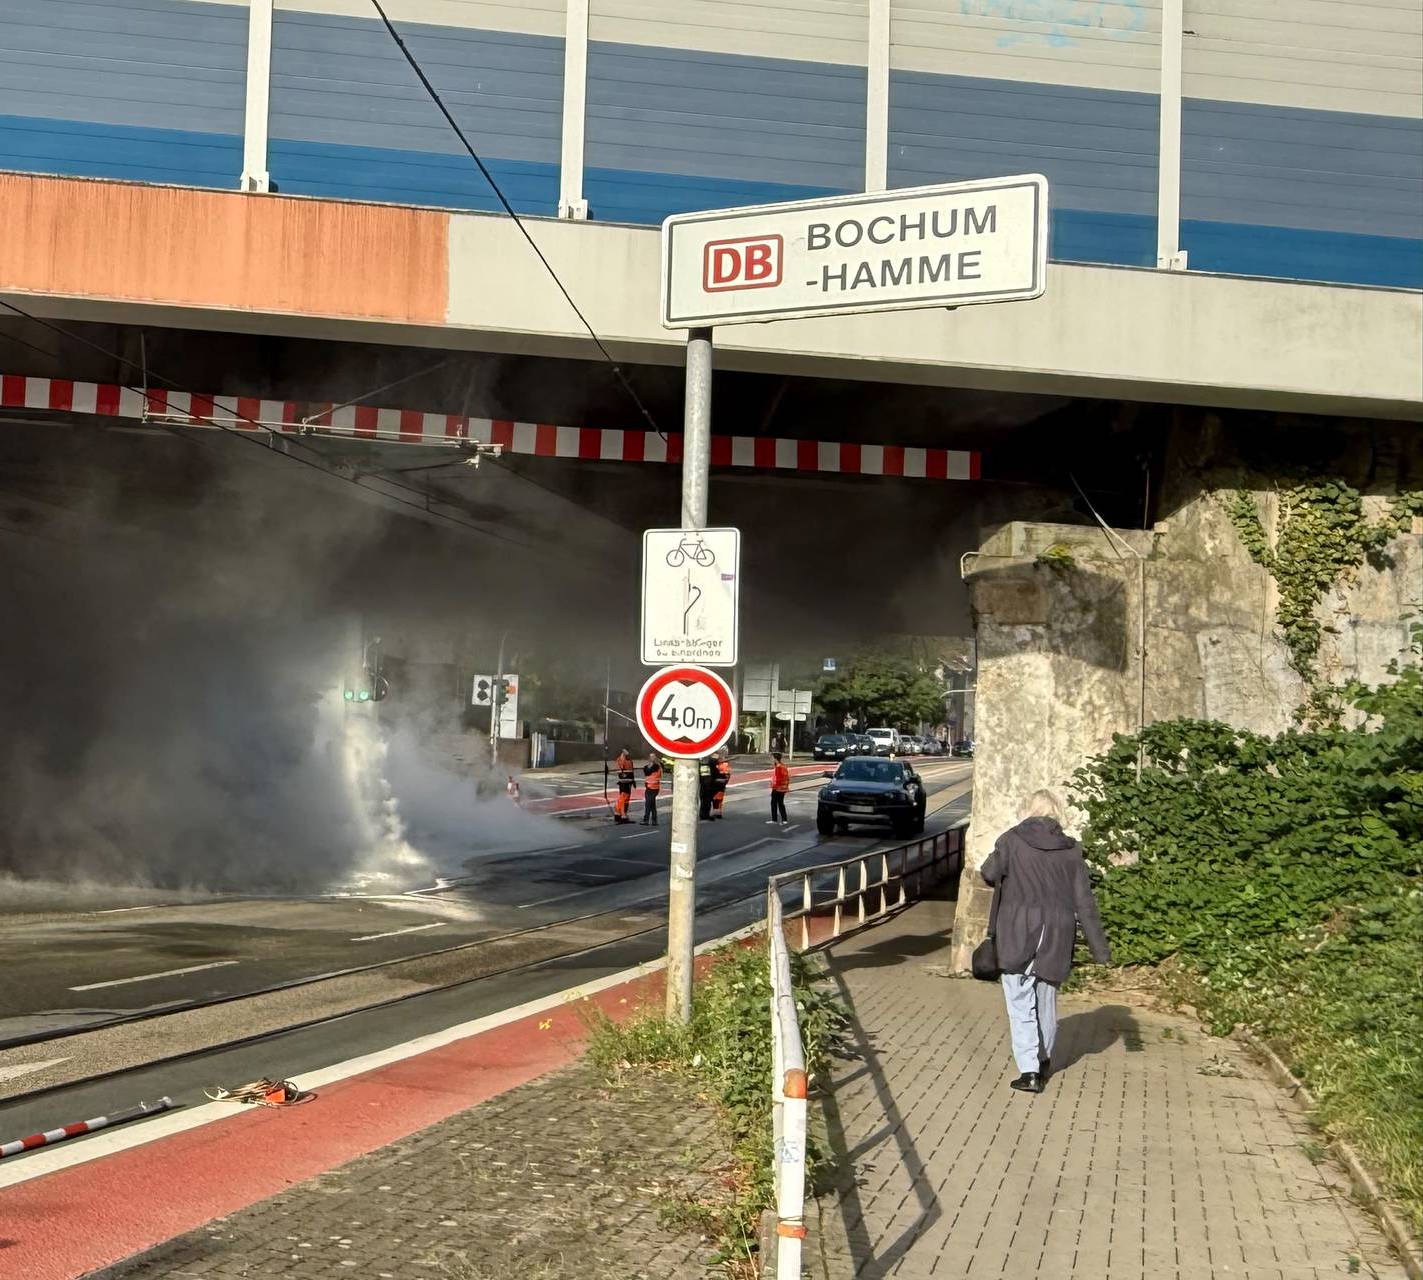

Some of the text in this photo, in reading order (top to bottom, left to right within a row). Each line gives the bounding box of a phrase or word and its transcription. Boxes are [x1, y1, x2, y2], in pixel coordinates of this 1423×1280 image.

[807, 205, 997, 251] BOCHUM
[712, 243, 773, 284] DB
[806, 250, 982, 292] -HAMME
